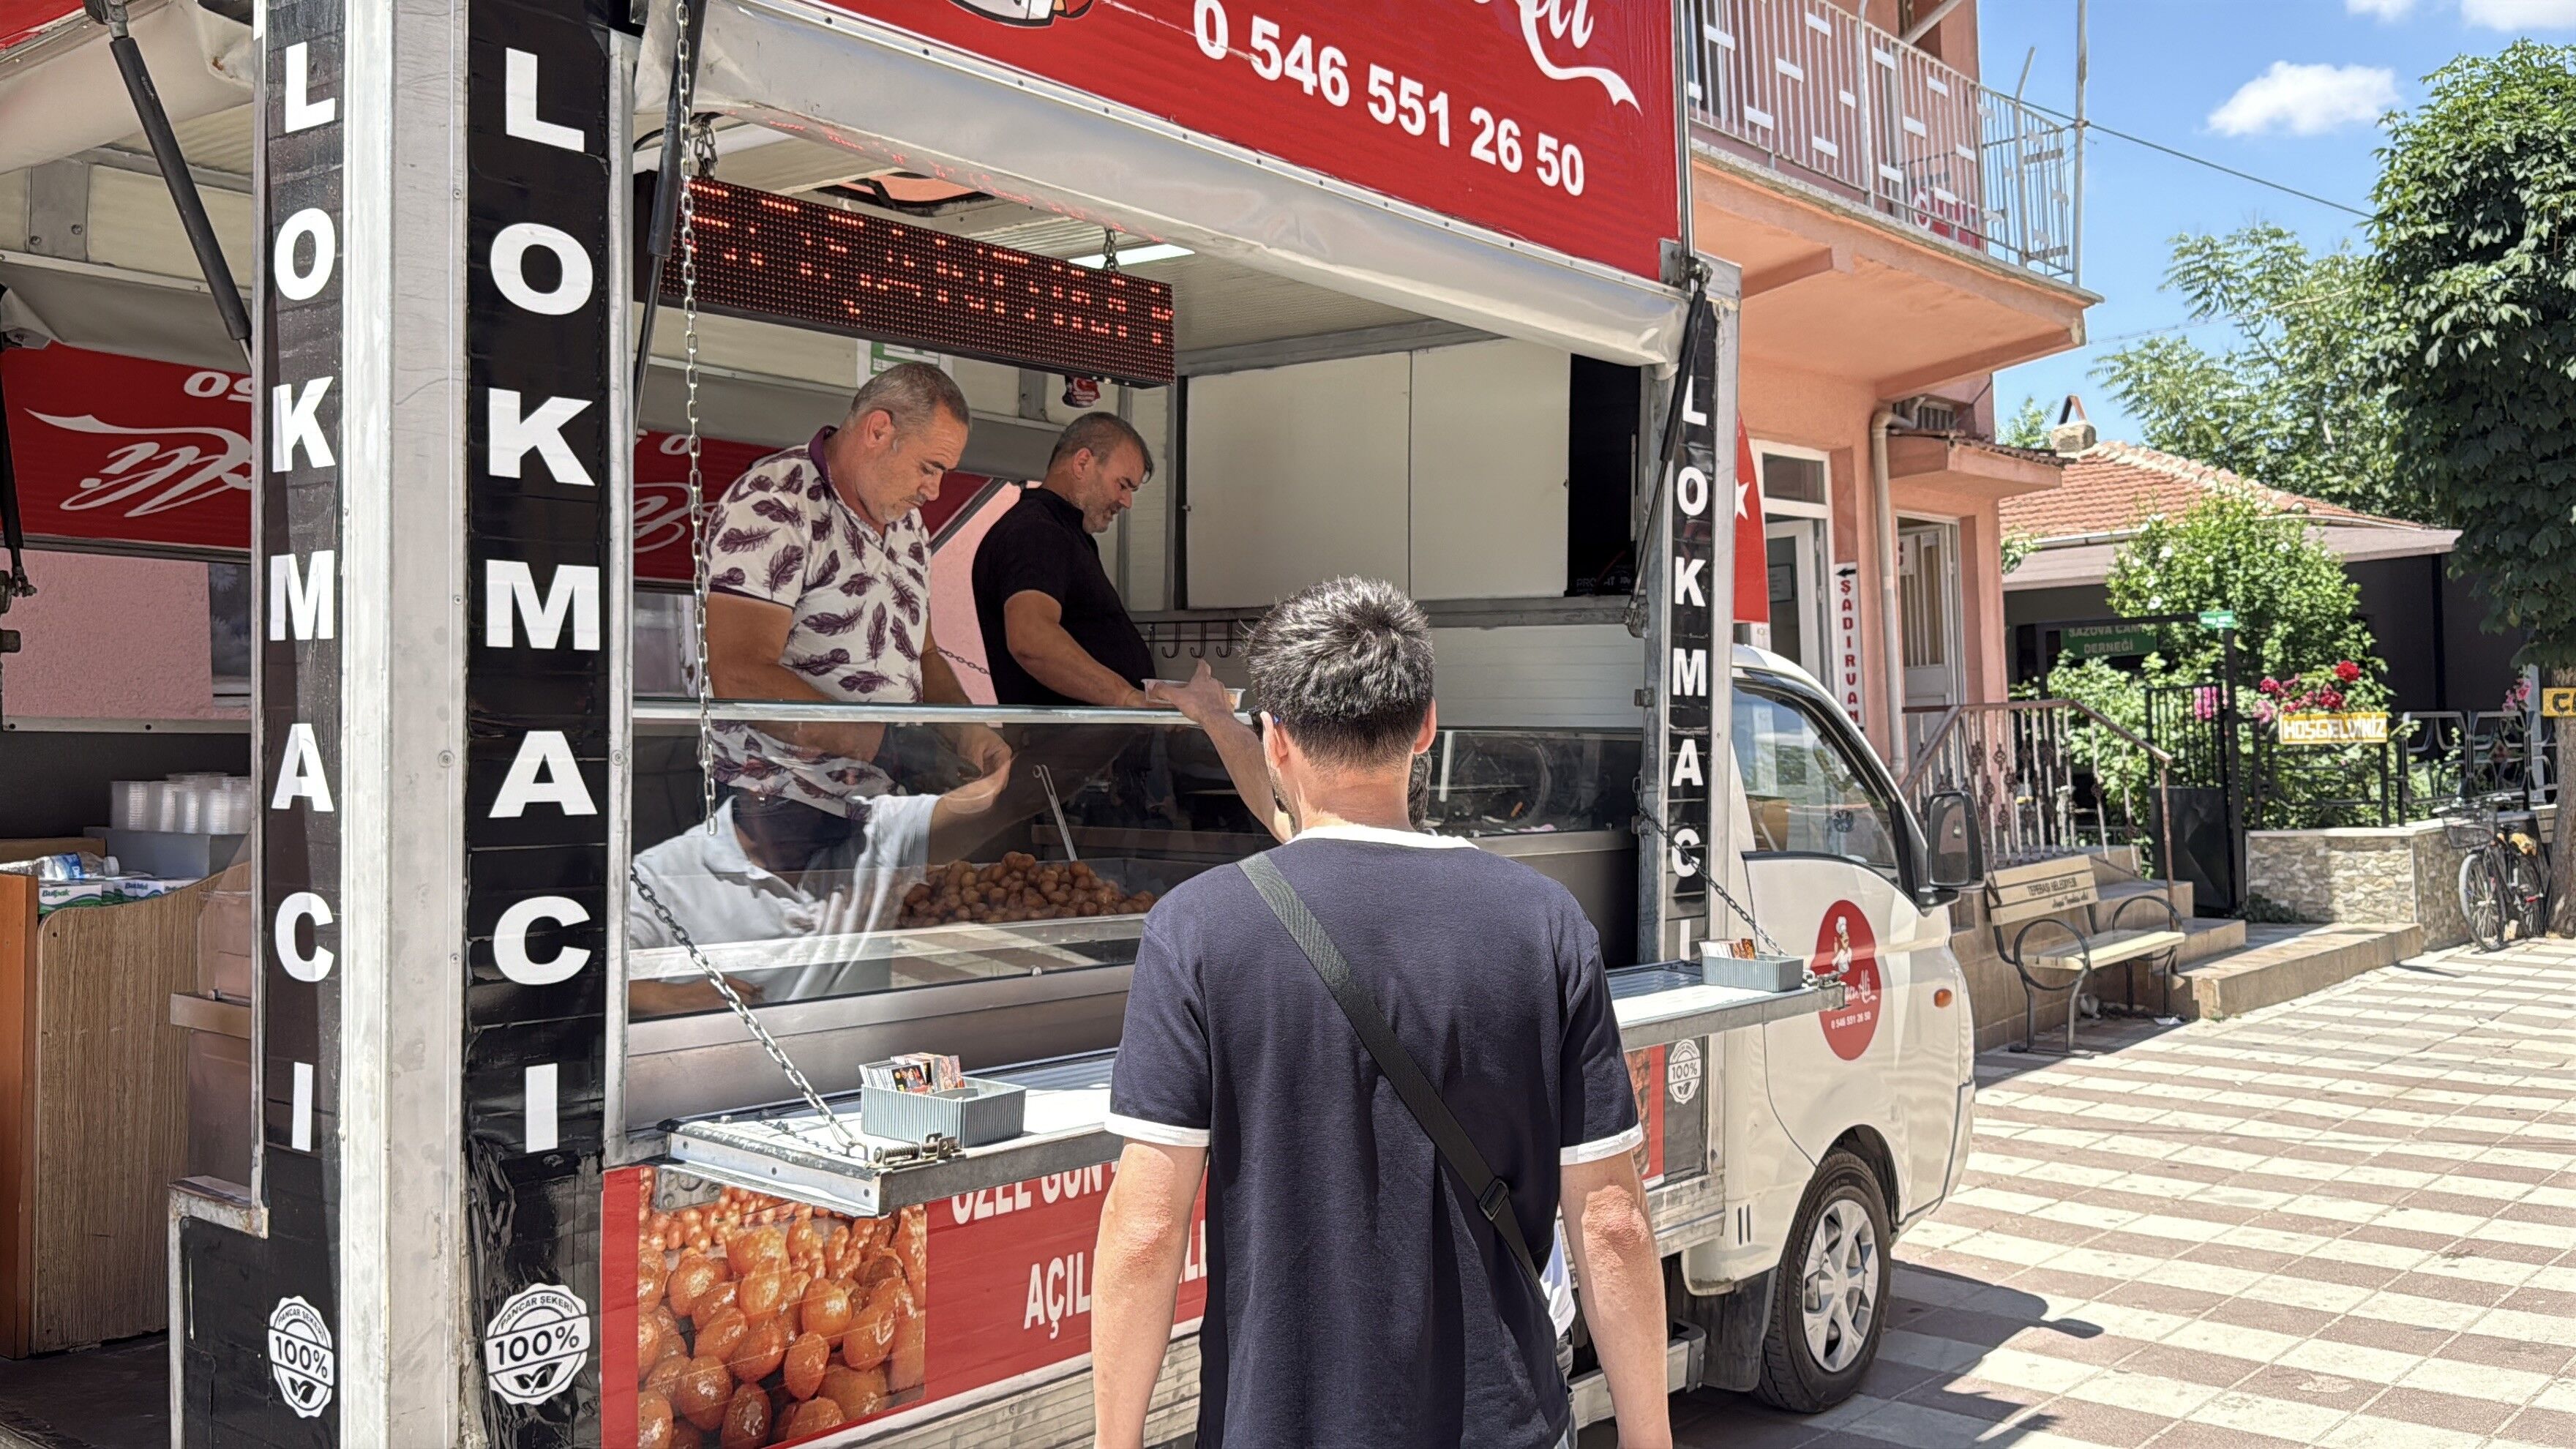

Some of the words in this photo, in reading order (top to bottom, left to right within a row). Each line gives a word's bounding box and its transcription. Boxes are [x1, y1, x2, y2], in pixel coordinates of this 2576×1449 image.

[1194, 0, 1229, 60] 0
[1251, 15, 1349, 107] 546
[1366, 62, 1450, 148] 551
[1469, 107, 1523, 173] 26
[1536, 132, 1584, 197] 50
[270, 42, 337, 1153] LOKMACI
[485, 48, 601, 1153] LOKMACI
[1671, 373, 1707, 961] LOKMACI
[1672, 1061, 1698, 1079] 100%
[501, 1297, 538, 1330] PANCAR
[539, 1295, 574, 1314] ŞEKERİ
[1023, 1248, 1096, 1340] AÇIL
[275, 1336, 328, 1379] 100%
[494, 1323, 580, 1366] 100%
